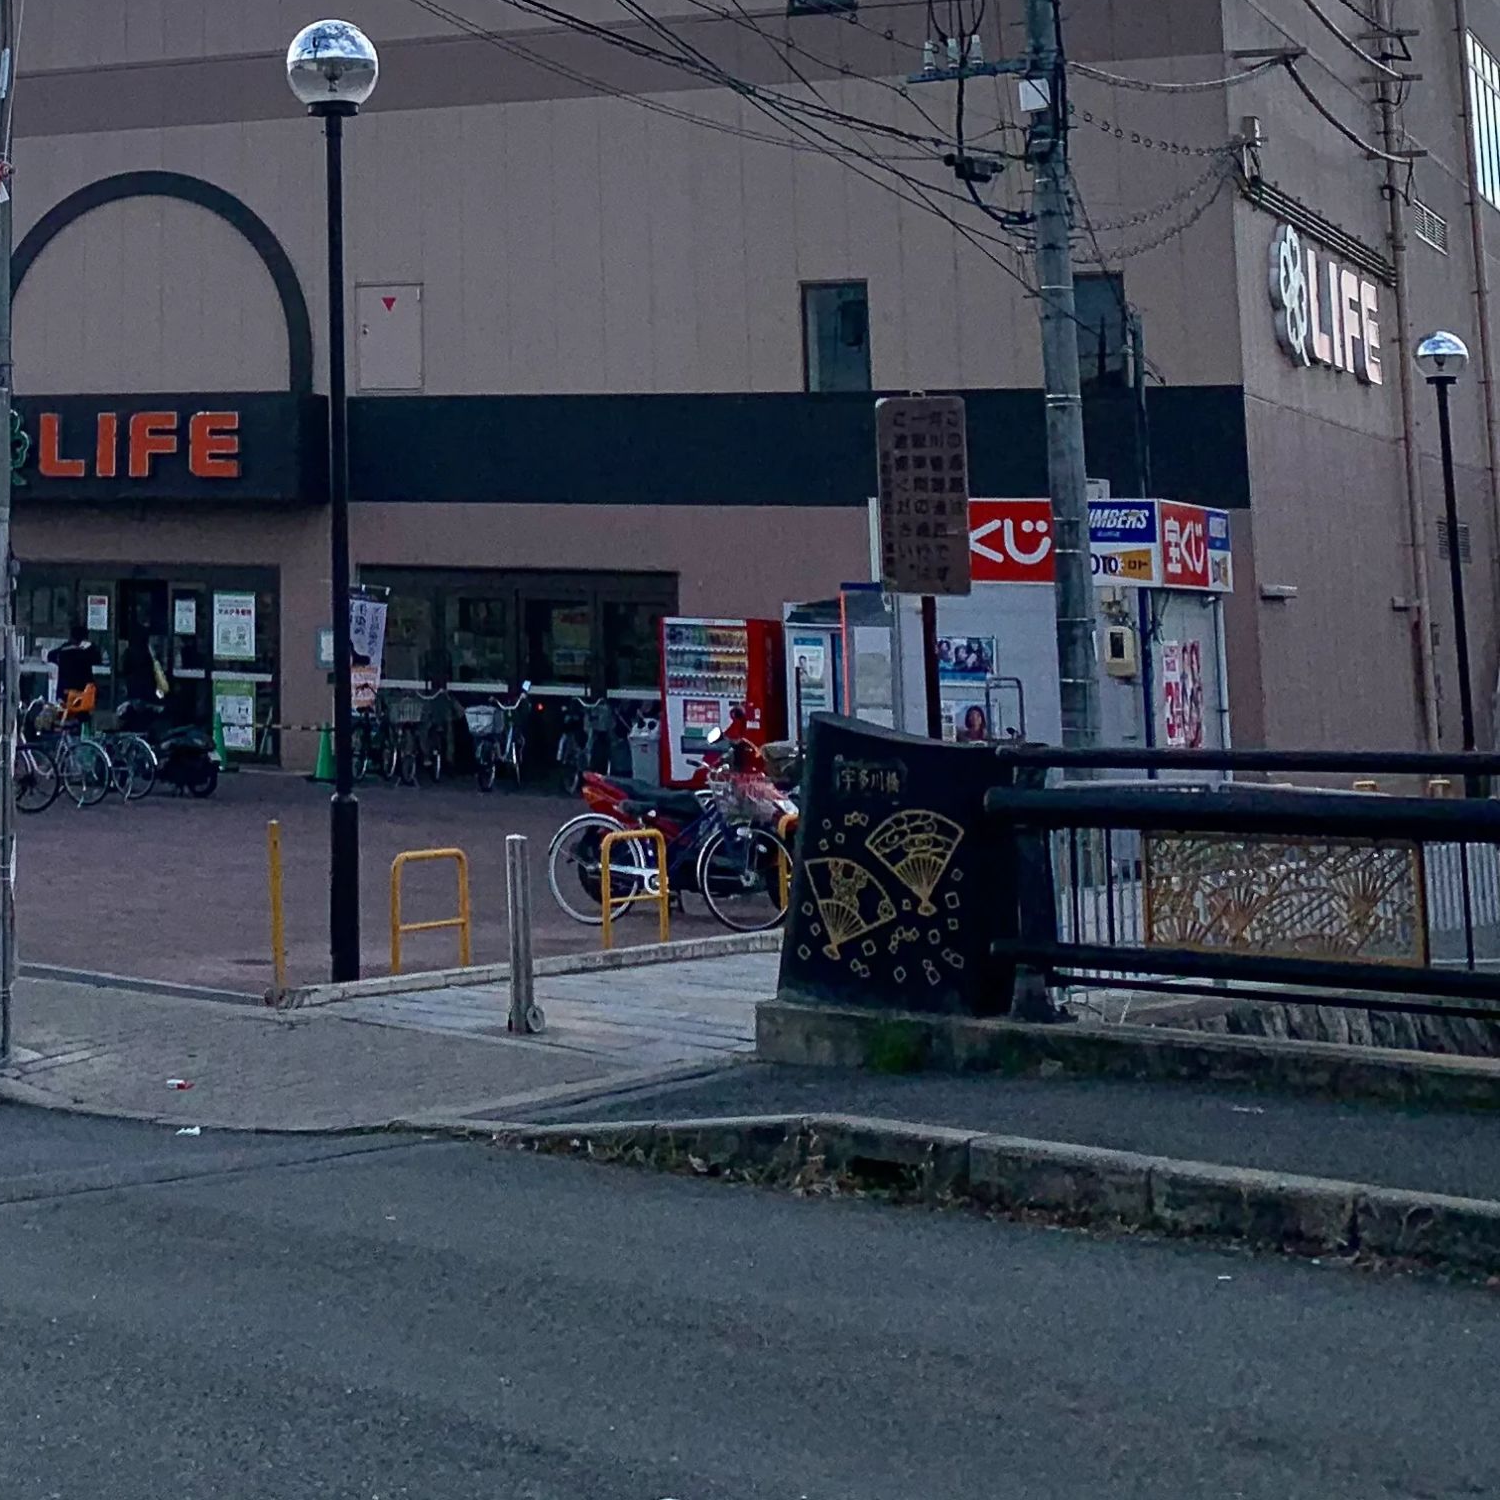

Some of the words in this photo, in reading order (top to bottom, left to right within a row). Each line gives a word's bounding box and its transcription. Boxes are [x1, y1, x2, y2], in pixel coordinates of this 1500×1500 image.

[1306, 248, 1383, 385] LIFE
[39, 411, 239, 477] LIFE
[1164, 516, 1205, 574] 宝くじ
